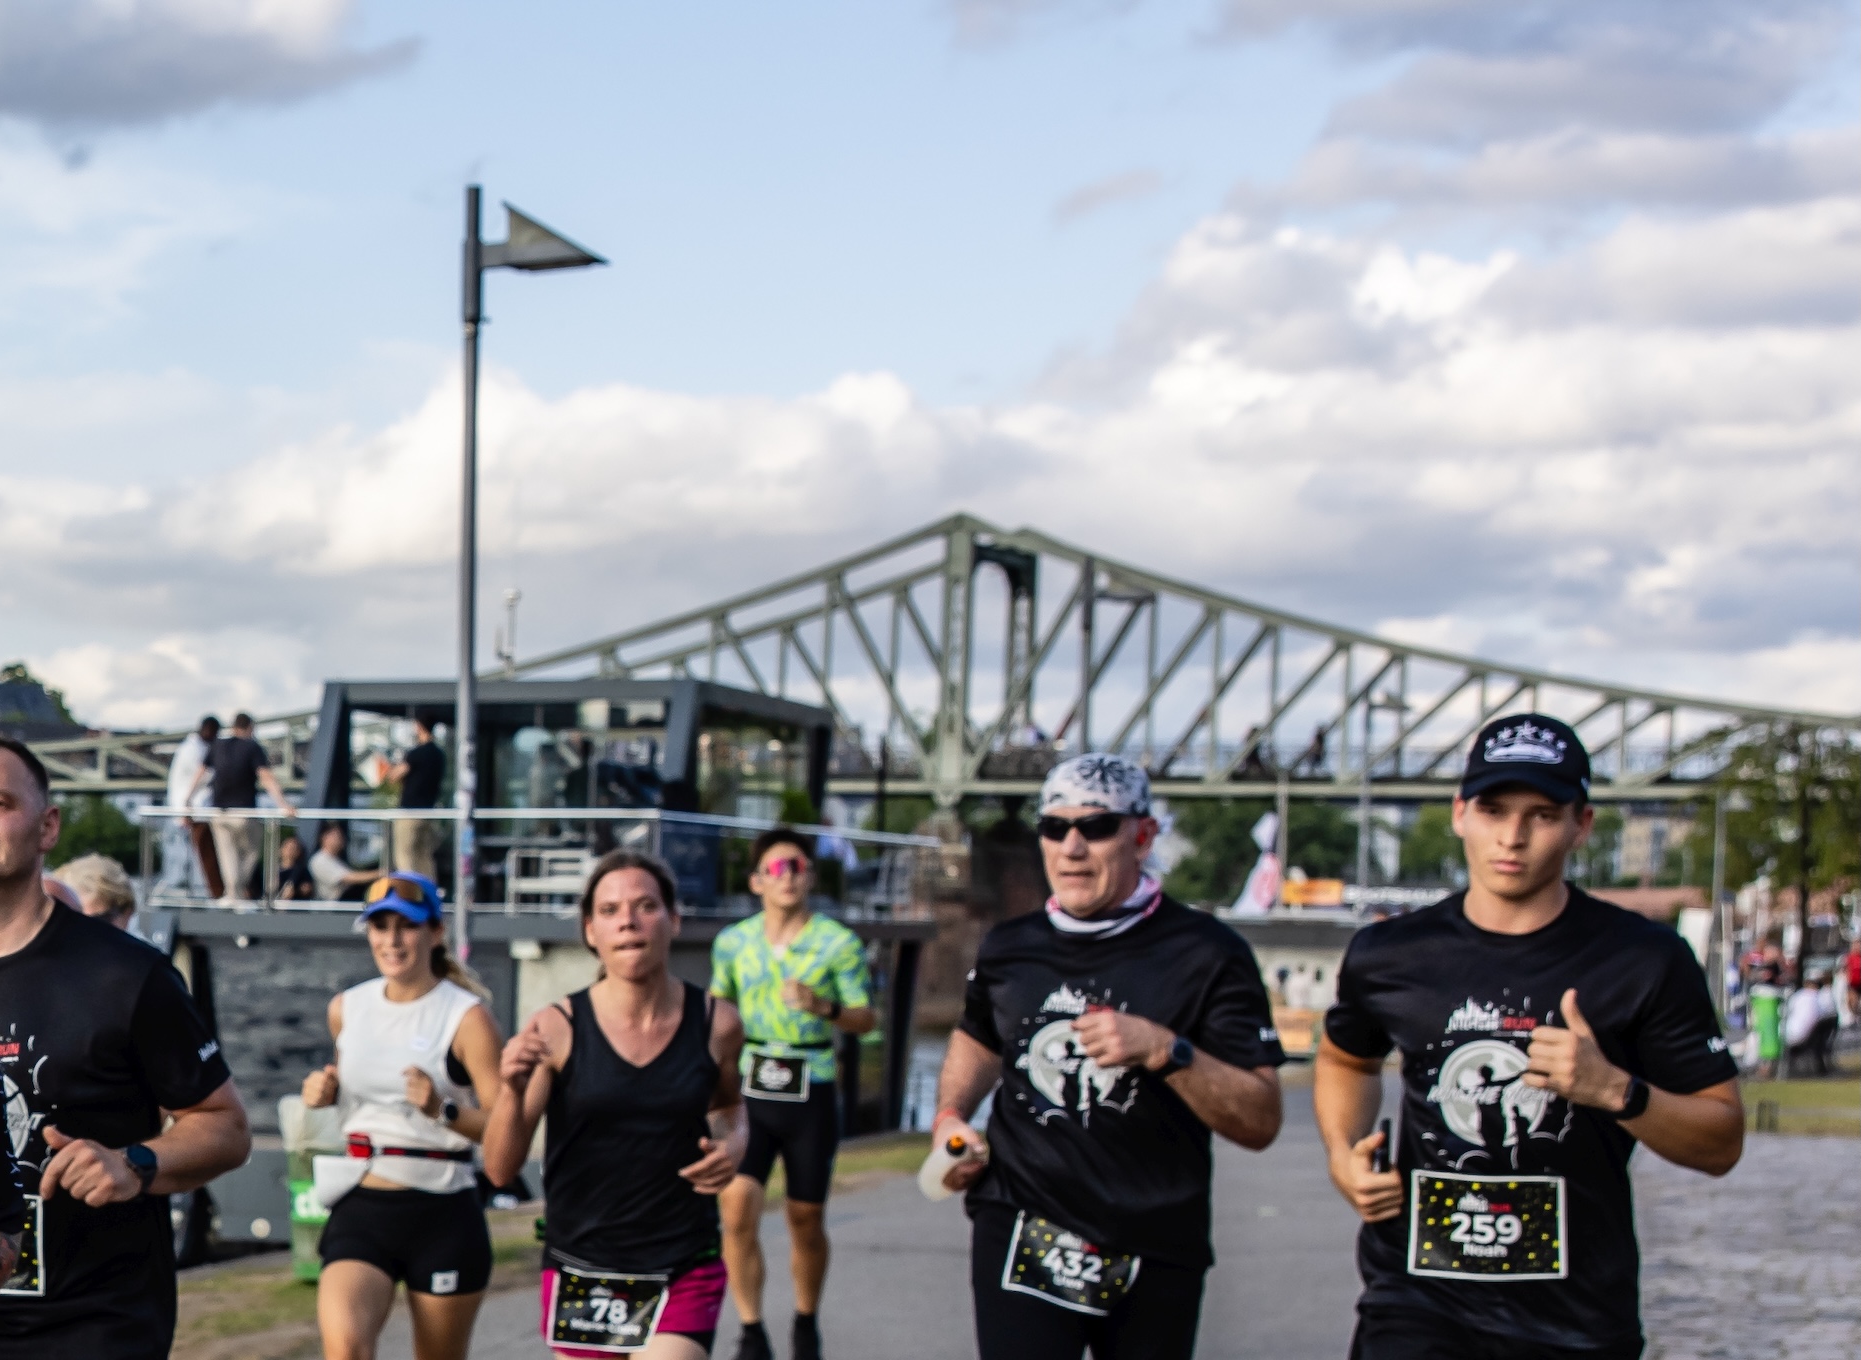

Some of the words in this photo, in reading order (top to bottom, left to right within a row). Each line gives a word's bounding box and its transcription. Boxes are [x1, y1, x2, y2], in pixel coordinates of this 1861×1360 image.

[1450, 1212, 1522, 1245] 259
[1042, 1247, 1103, 1284] 432
[589, 1298, 628, 1325] 78
